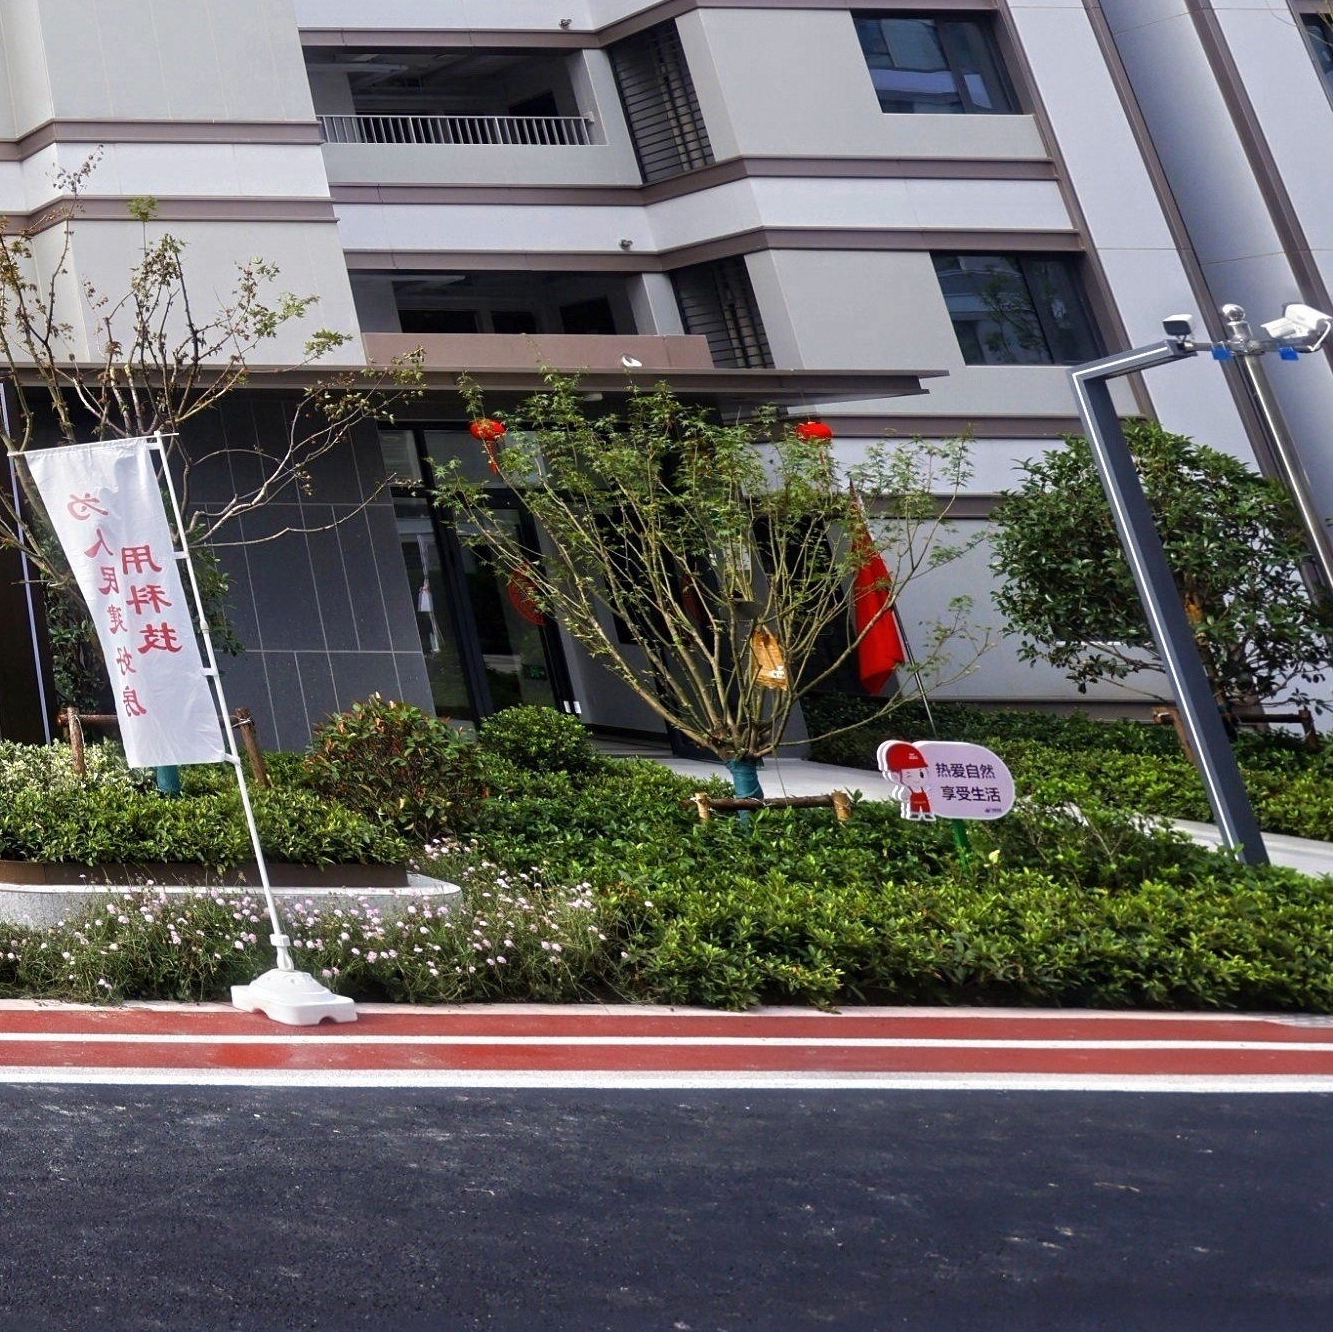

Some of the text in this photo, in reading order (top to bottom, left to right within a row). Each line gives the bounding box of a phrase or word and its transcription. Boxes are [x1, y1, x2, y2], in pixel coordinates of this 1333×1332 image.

[935, 762, 996, 779] 热爱自然
[940, 786, 1002, 802] 享受生活
